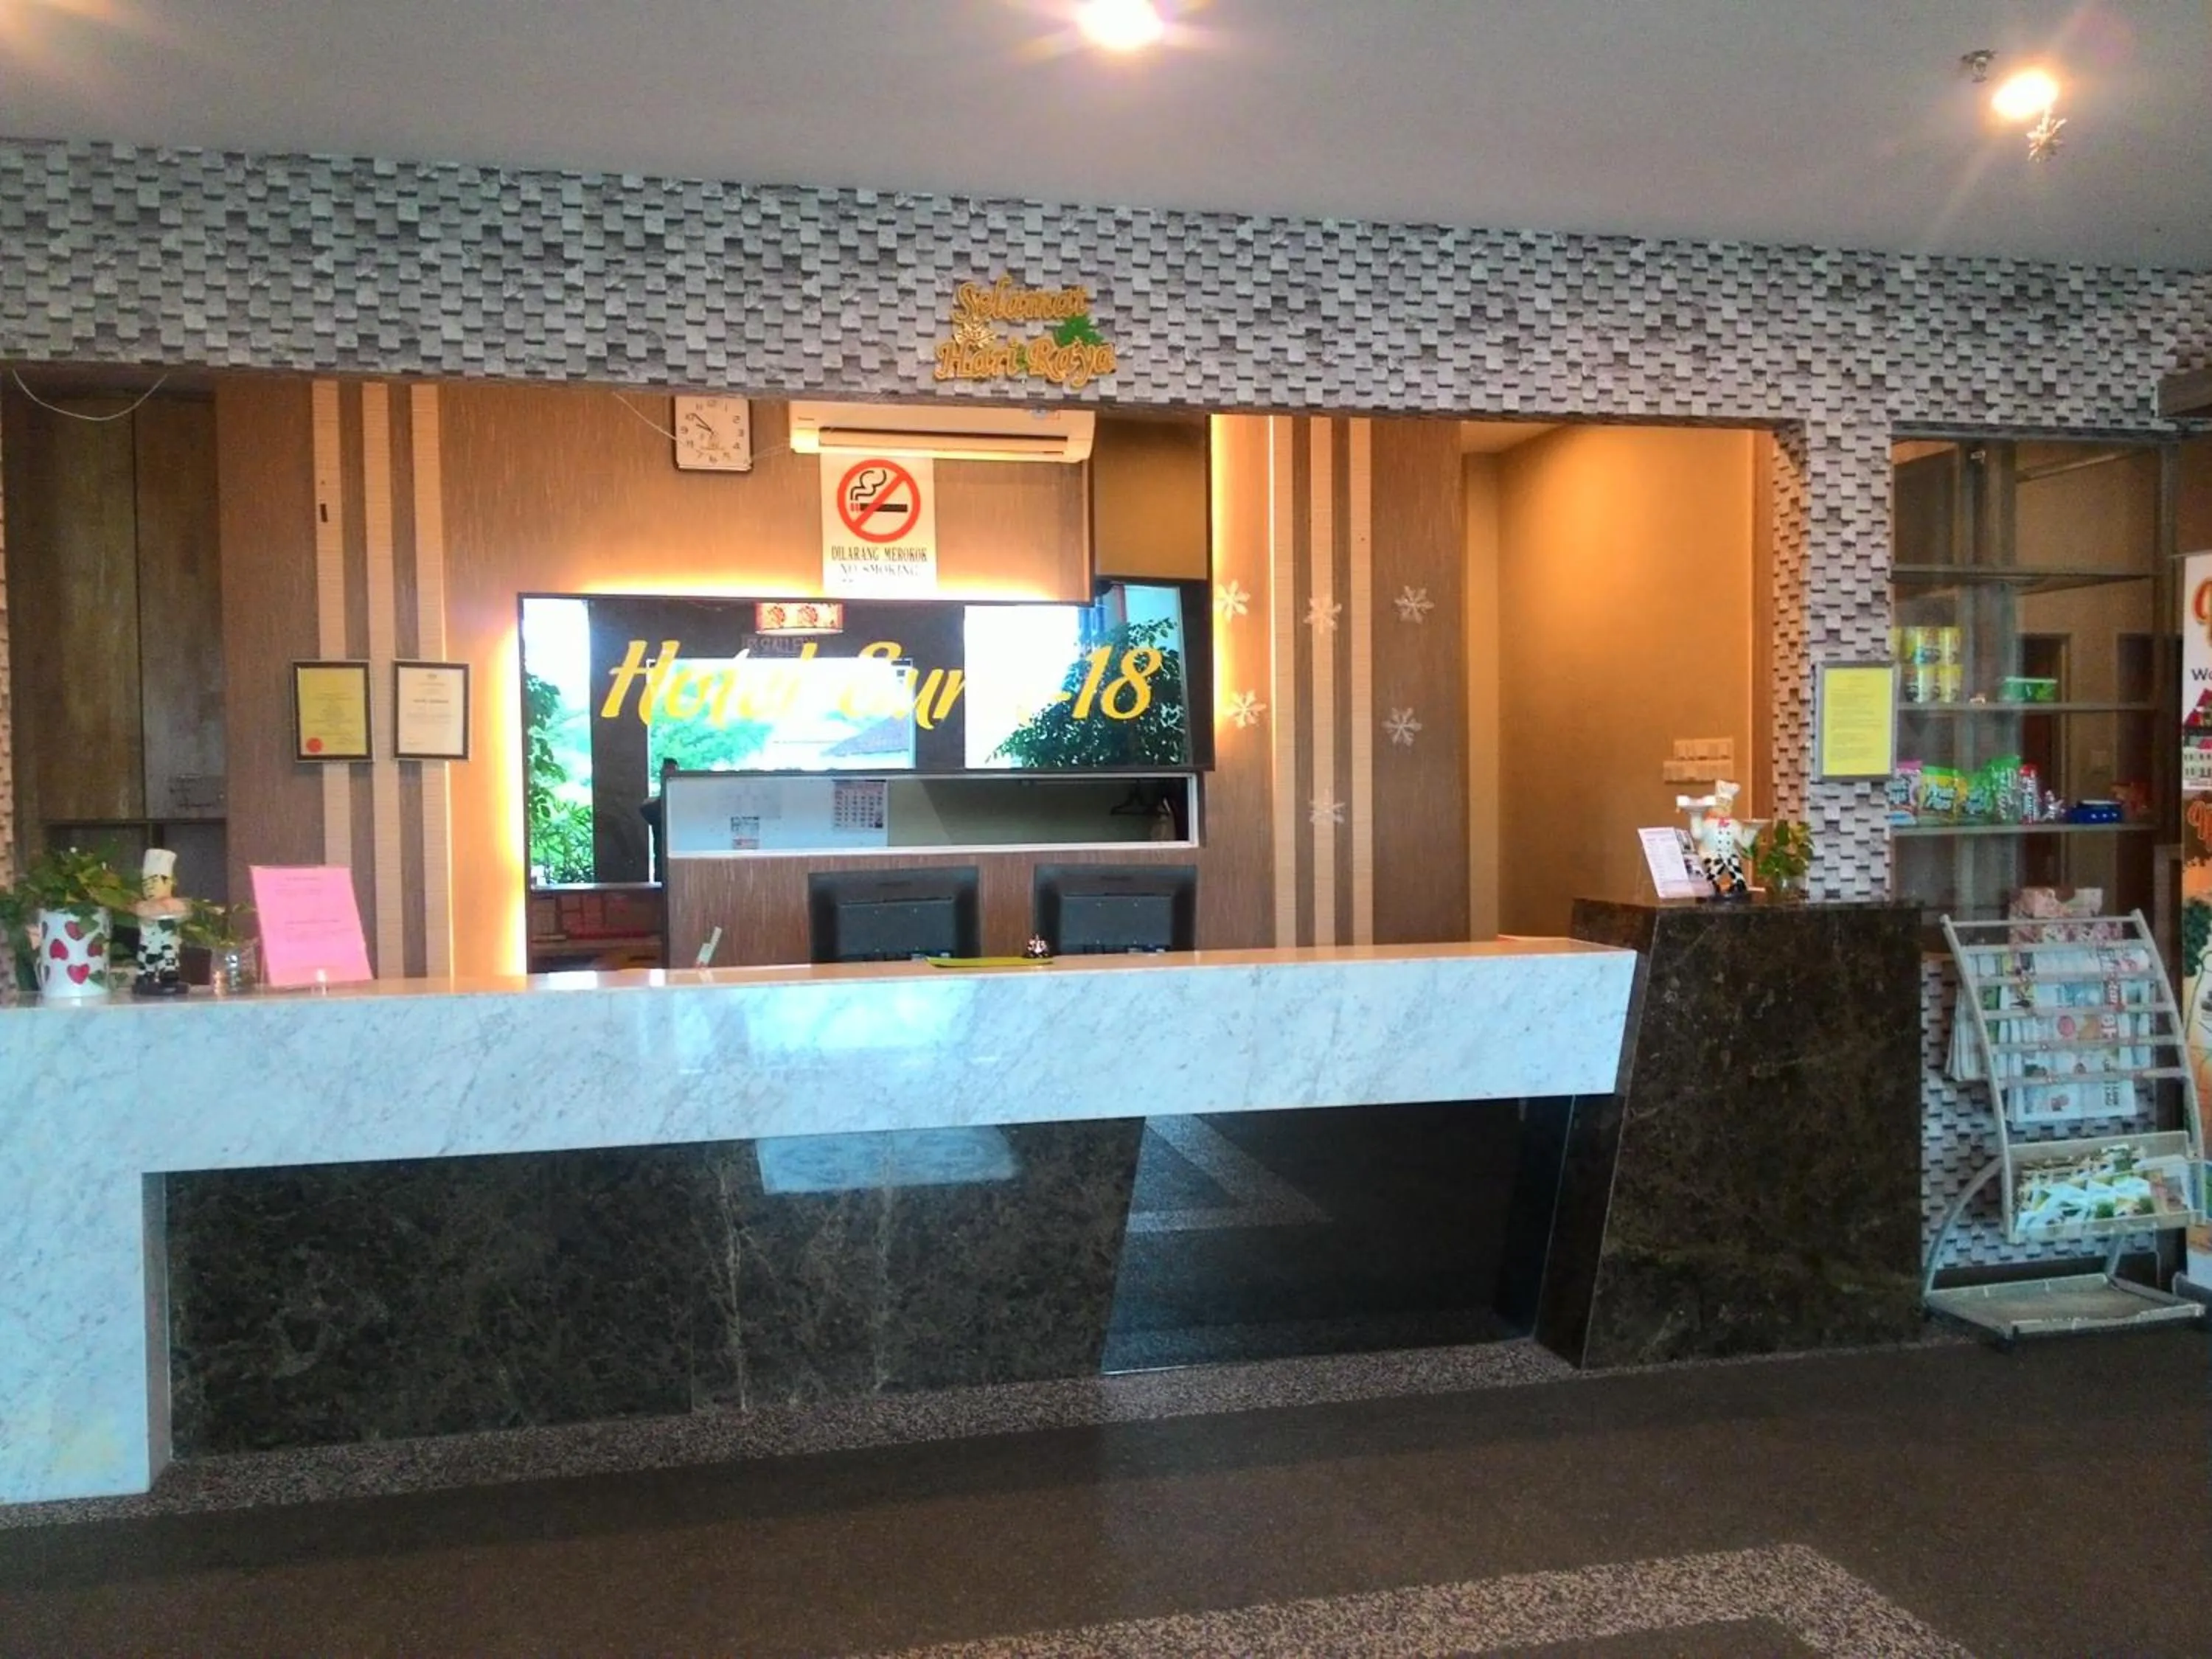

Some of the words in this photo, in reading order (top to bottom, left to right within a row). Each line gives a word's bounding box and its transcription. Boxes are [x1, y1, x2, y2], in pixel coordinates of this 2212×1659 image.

[952, 274, 1088, 323] Selamat
[935, 340, 1020, 380] Hari
[1026, 335, 1118, 389] Raya
[831, 546, 880, 561] DILARANG
[884, 547, 928, 562] MEROKOK
